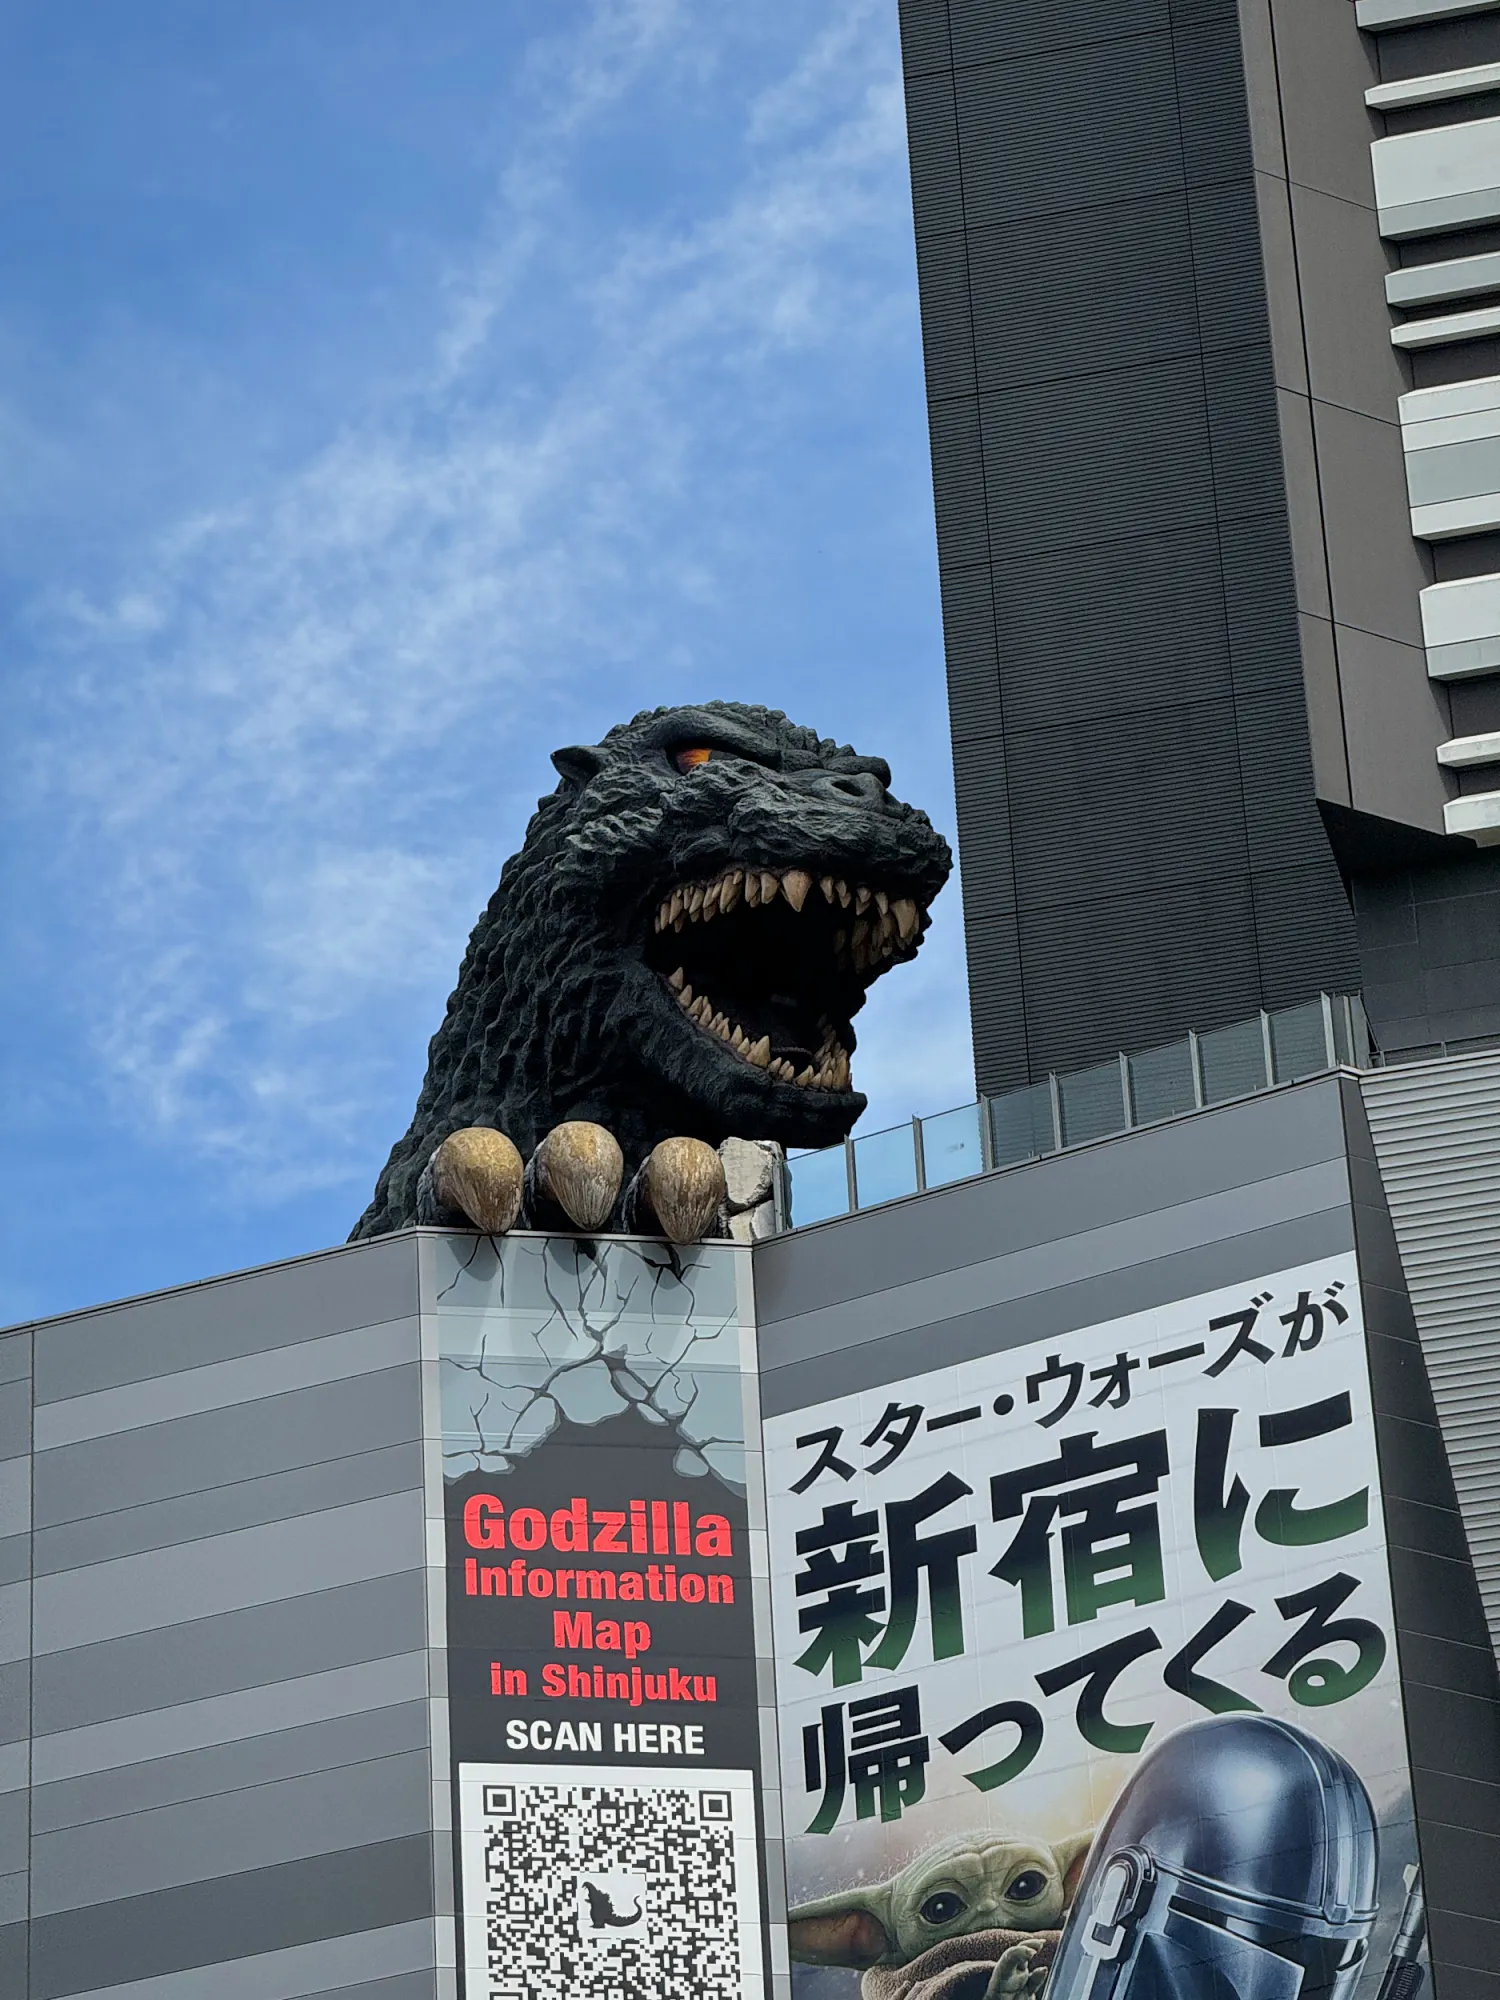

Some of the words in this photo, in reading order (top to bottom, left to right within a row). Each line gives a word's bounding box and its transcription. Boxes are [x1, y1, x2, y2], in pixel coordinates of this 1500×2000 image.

[789, 1281, 1349, 1495] スター・ウォーズが
[463, 1494, 733, 1557] Godzilla
[793, 1390, 1370, 1688] 新宿に
[464, 1558, 735, 1604] Information
[553, 1610, 652, 1659] Map
[490, 1662, 528, 1696] in
[541, 1663, 717, 1707] Shinjuku
[804, 1572, 1387, 1834] 帰ってくる
[506, 1719, 602, 1752] SCAN
[613, 1722, 705, 1755] HERE
